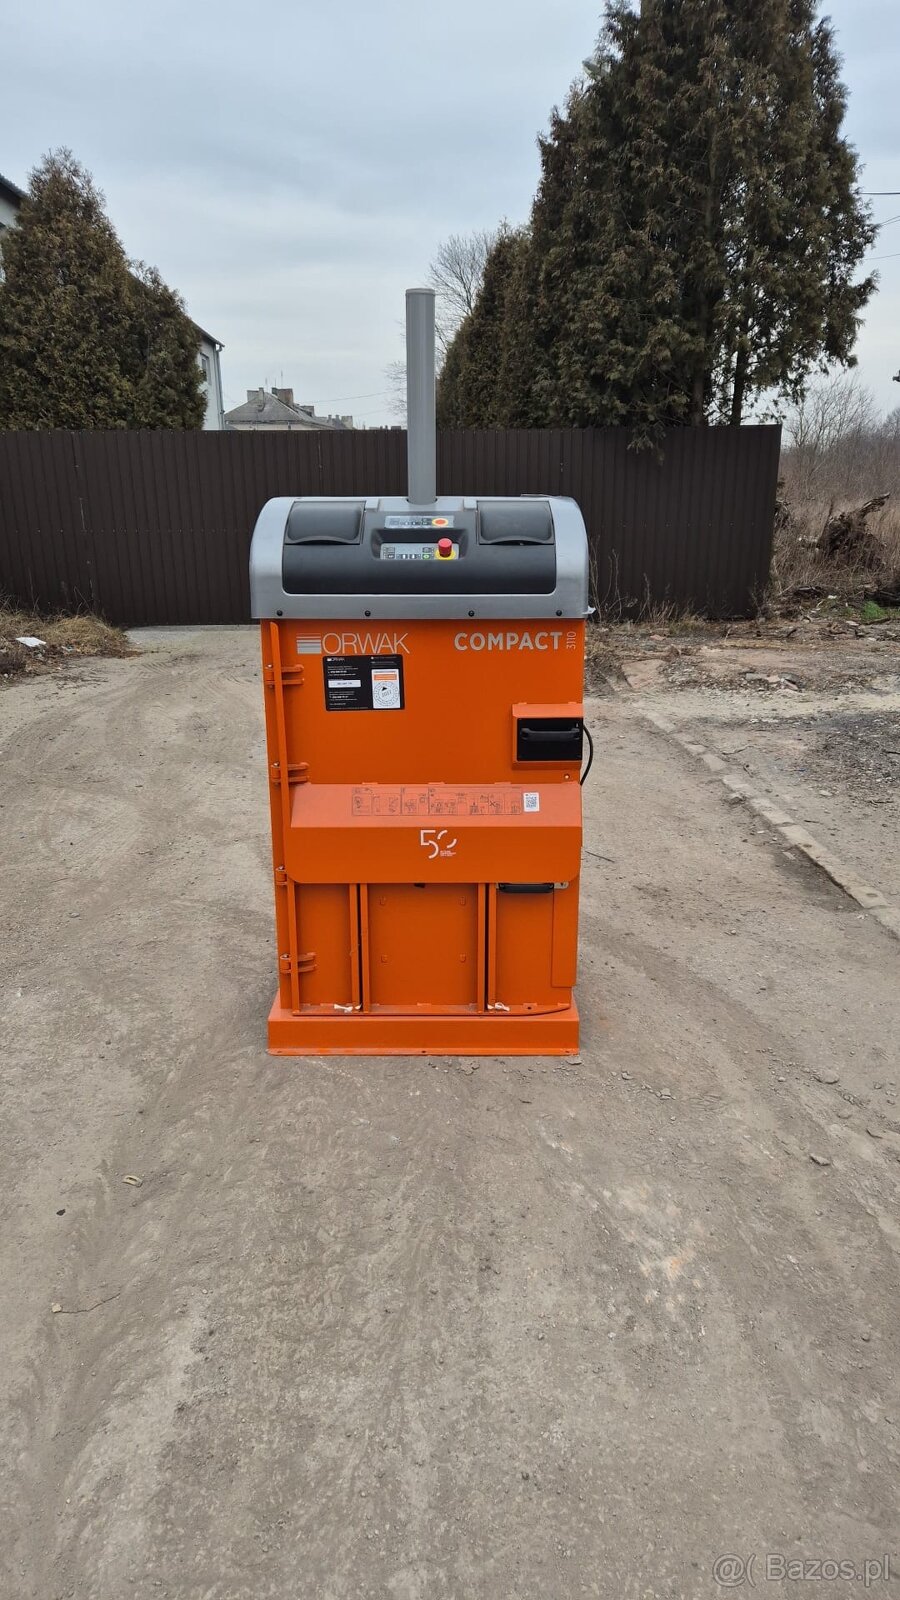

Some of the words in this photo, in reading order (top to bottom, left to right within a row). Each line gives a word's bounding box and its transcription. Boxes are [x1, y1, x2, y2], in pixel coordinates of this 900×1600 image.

[322, 632, 410, 655] ORWAK
[454, 631, 562, 651] COMPACT
[566, 631, 577, 650] 3110
